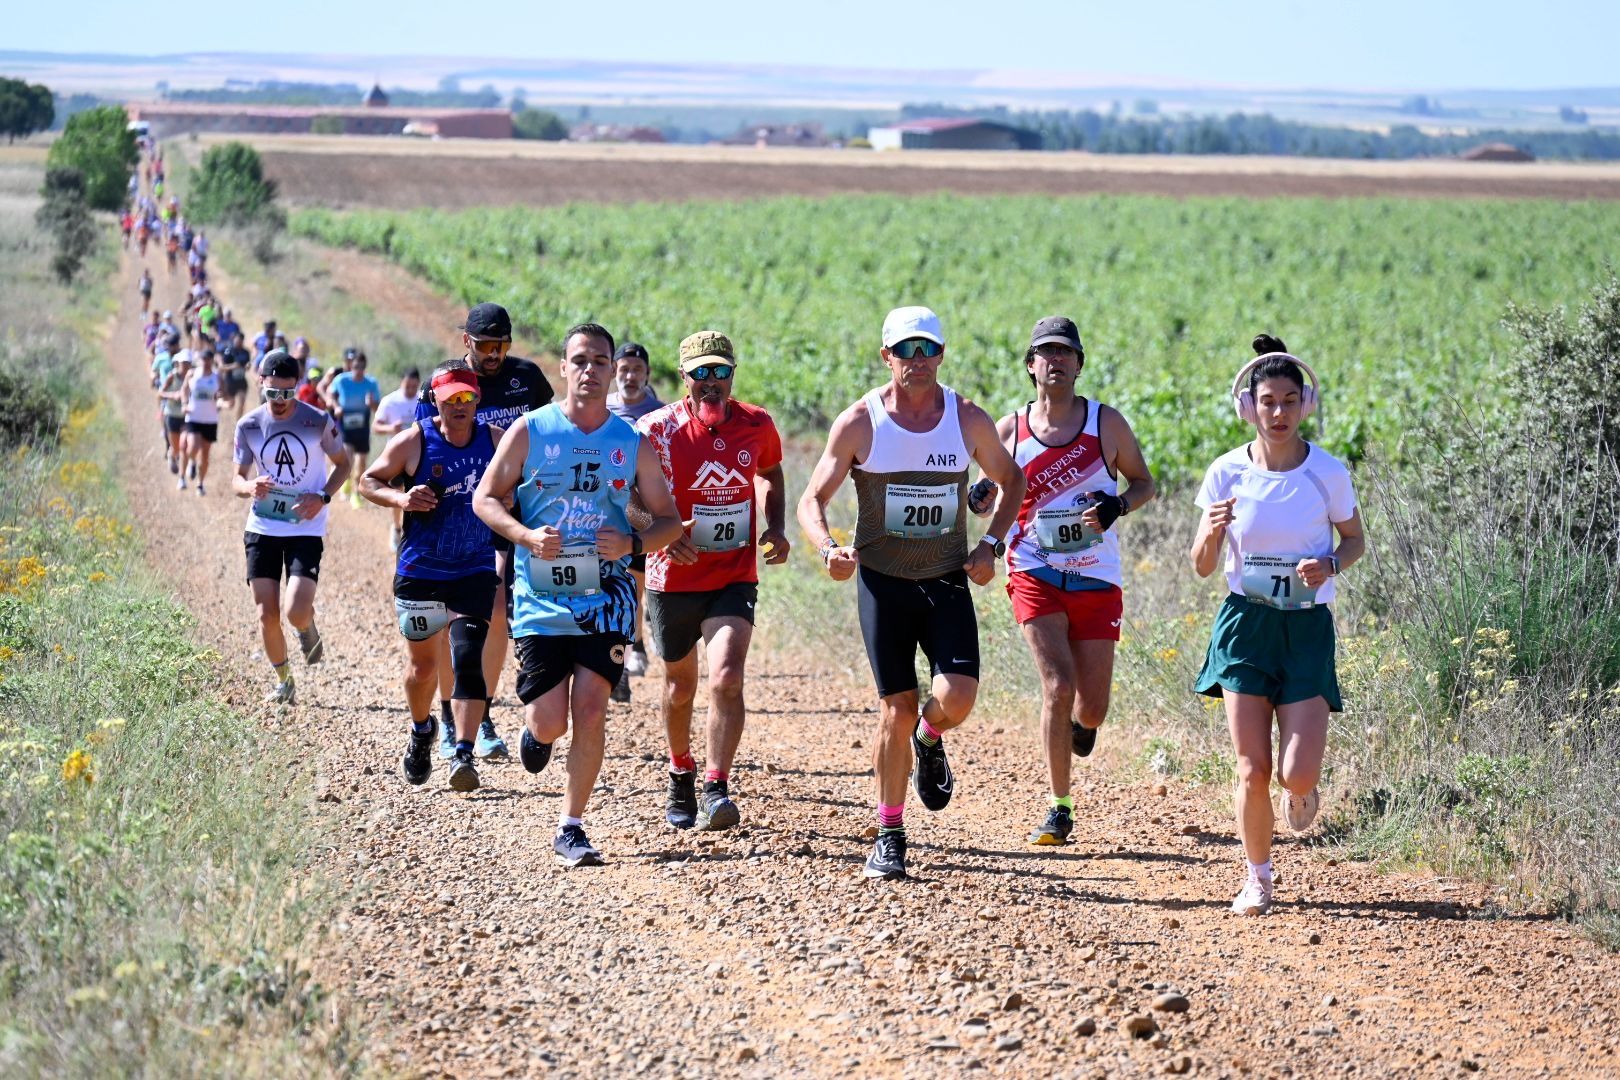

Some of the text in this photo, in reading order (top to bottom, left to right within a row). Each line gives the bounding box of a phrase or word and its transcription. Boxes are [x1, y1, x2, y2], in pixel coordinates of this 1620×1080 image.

[476, 404, 529, 425] RUNNING
[925, 453, 957, 467] ANR
[1026, 444, 1087, 493] LA DESPENSA
[568, 461, 601, 493] 15
[1046, 467, 1087, 494] FER
[272, 500, 287, 514] 74
[903, 505, 943, 527] 200
[713, 522, 736, 542] 26
[1058, 523, 1083, 543] 98
[552, 566, 577, 586] 59
[1271, 575, 1290, 597] 71
[409, 615, 428, 631] 19
